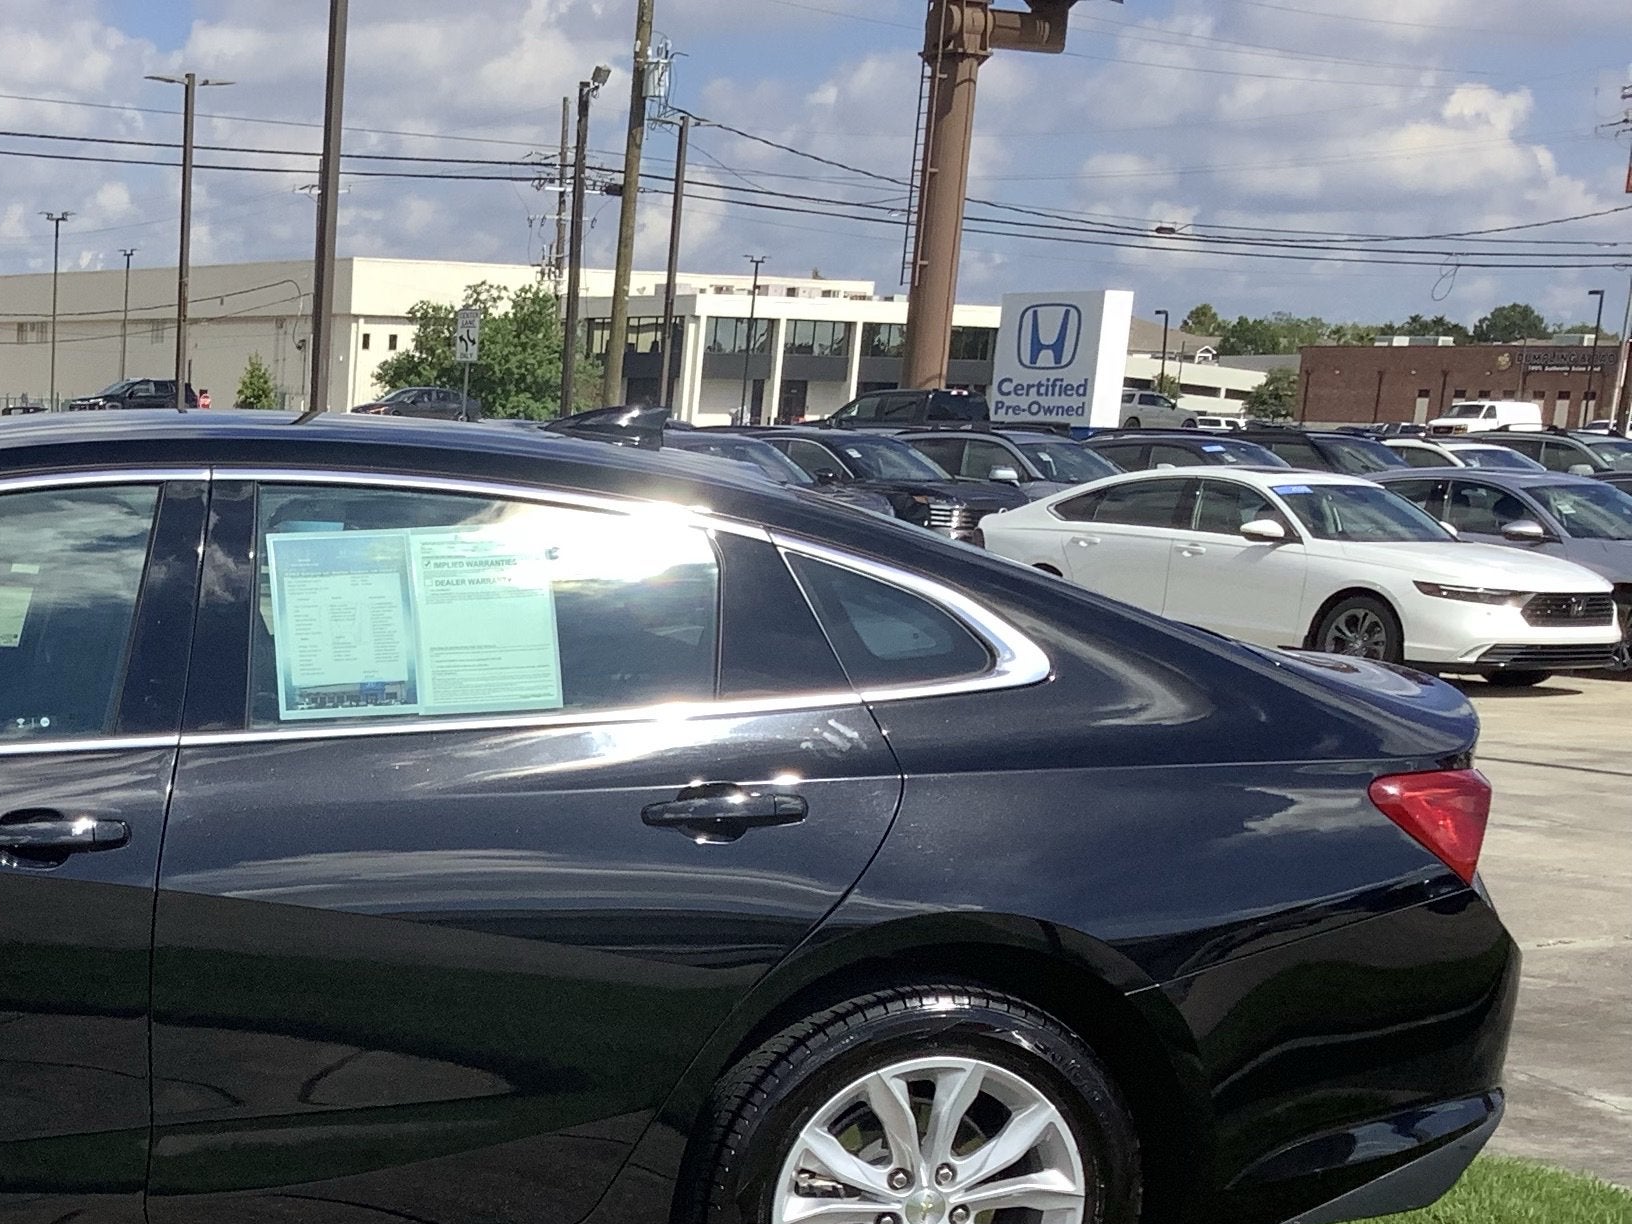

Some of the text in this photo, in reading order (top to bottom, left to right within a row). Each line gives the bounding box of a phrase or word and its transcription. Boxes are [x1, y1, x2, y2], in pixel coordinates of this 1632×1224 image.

[997, 378, 1088, 397] Certified
[994, 400, 1086, 417] Pre-Owned
[433, 560, 465, 569] IMPLIED
[435, 578, 467, 587] DEALER
